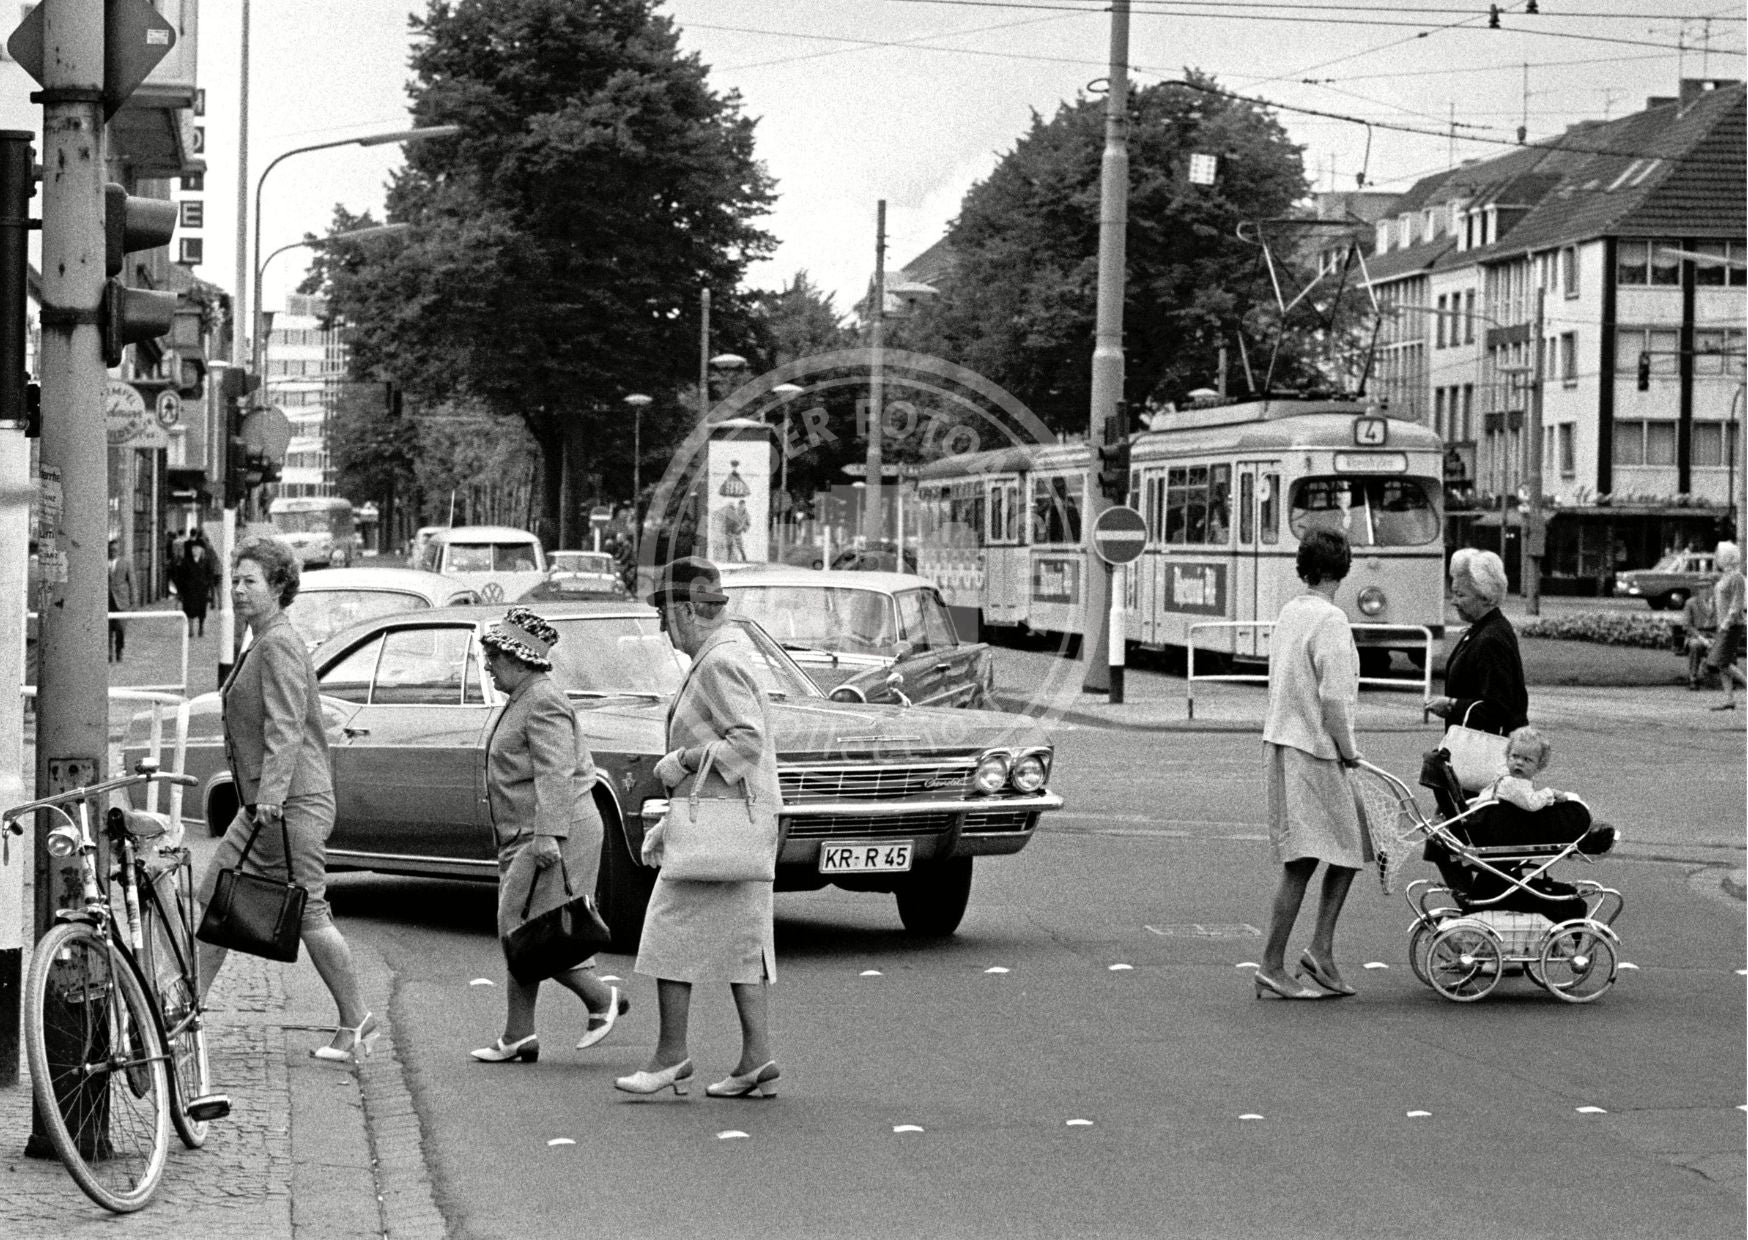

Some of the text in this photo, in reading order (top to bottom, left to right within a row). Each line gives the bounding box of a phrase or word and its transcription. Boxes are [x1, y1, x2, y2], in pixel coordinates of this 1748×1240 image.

[1364, 420, 1376, 441] 4
[865, 847, 879, 867] R
[885, 846, 908, 867] 45
